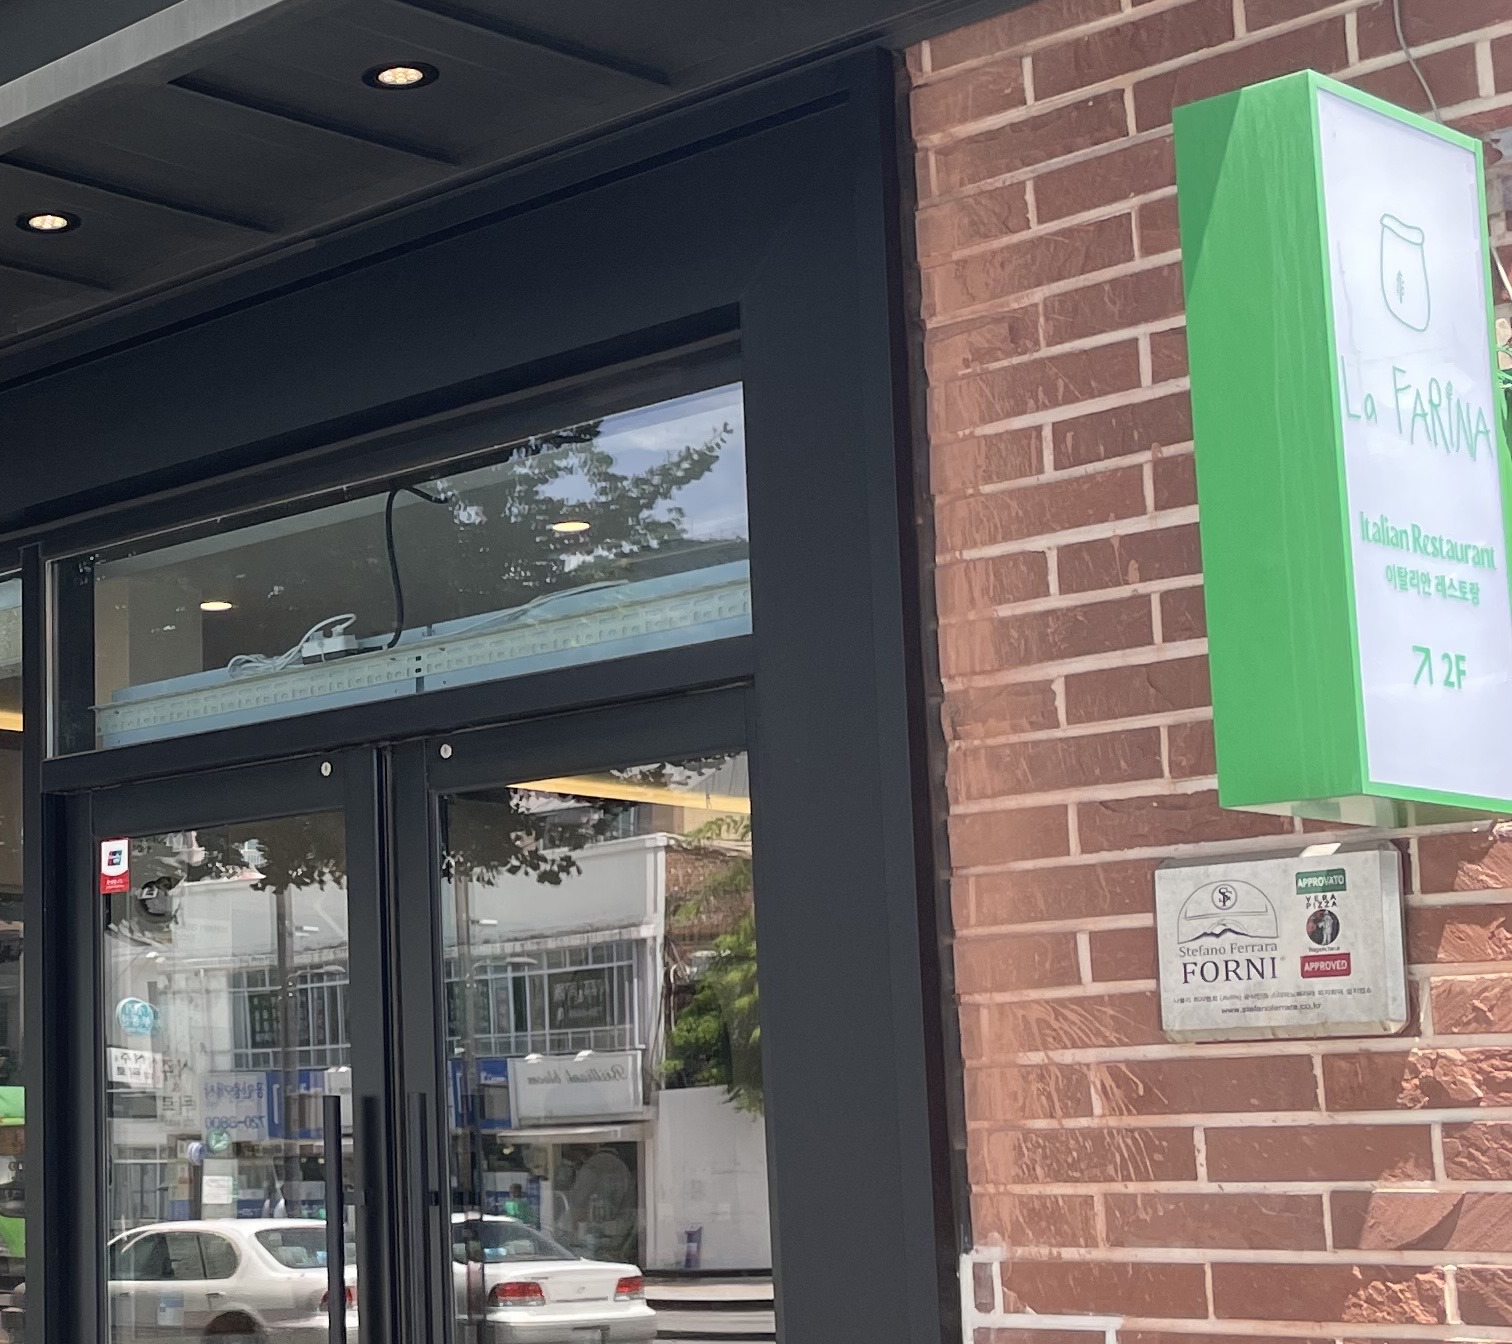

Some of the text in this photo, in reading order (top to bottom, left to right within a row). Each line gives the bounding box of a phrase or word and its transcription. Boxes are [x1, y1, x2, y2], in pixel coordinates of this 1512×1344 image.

[1341, 355, 1378, 424] La
[1359, 511, 1497, 570] Italian Restaurant
[1385, 563, 1480, 607] 이탈리안 레스토랑
[1441, 652, 1467, 690] 2F
[1297, 875, 1344, 888] APPROVATO
[1305, 894, 1337, 903] VERA
[1306, 901, 1338, 909] PIZZA
[1179, 942, 1278, 958] Stefano Ferrara
[1182, 956, 1278, 984] FORNI
[1304, 960, 1347, 972] APPROVED
